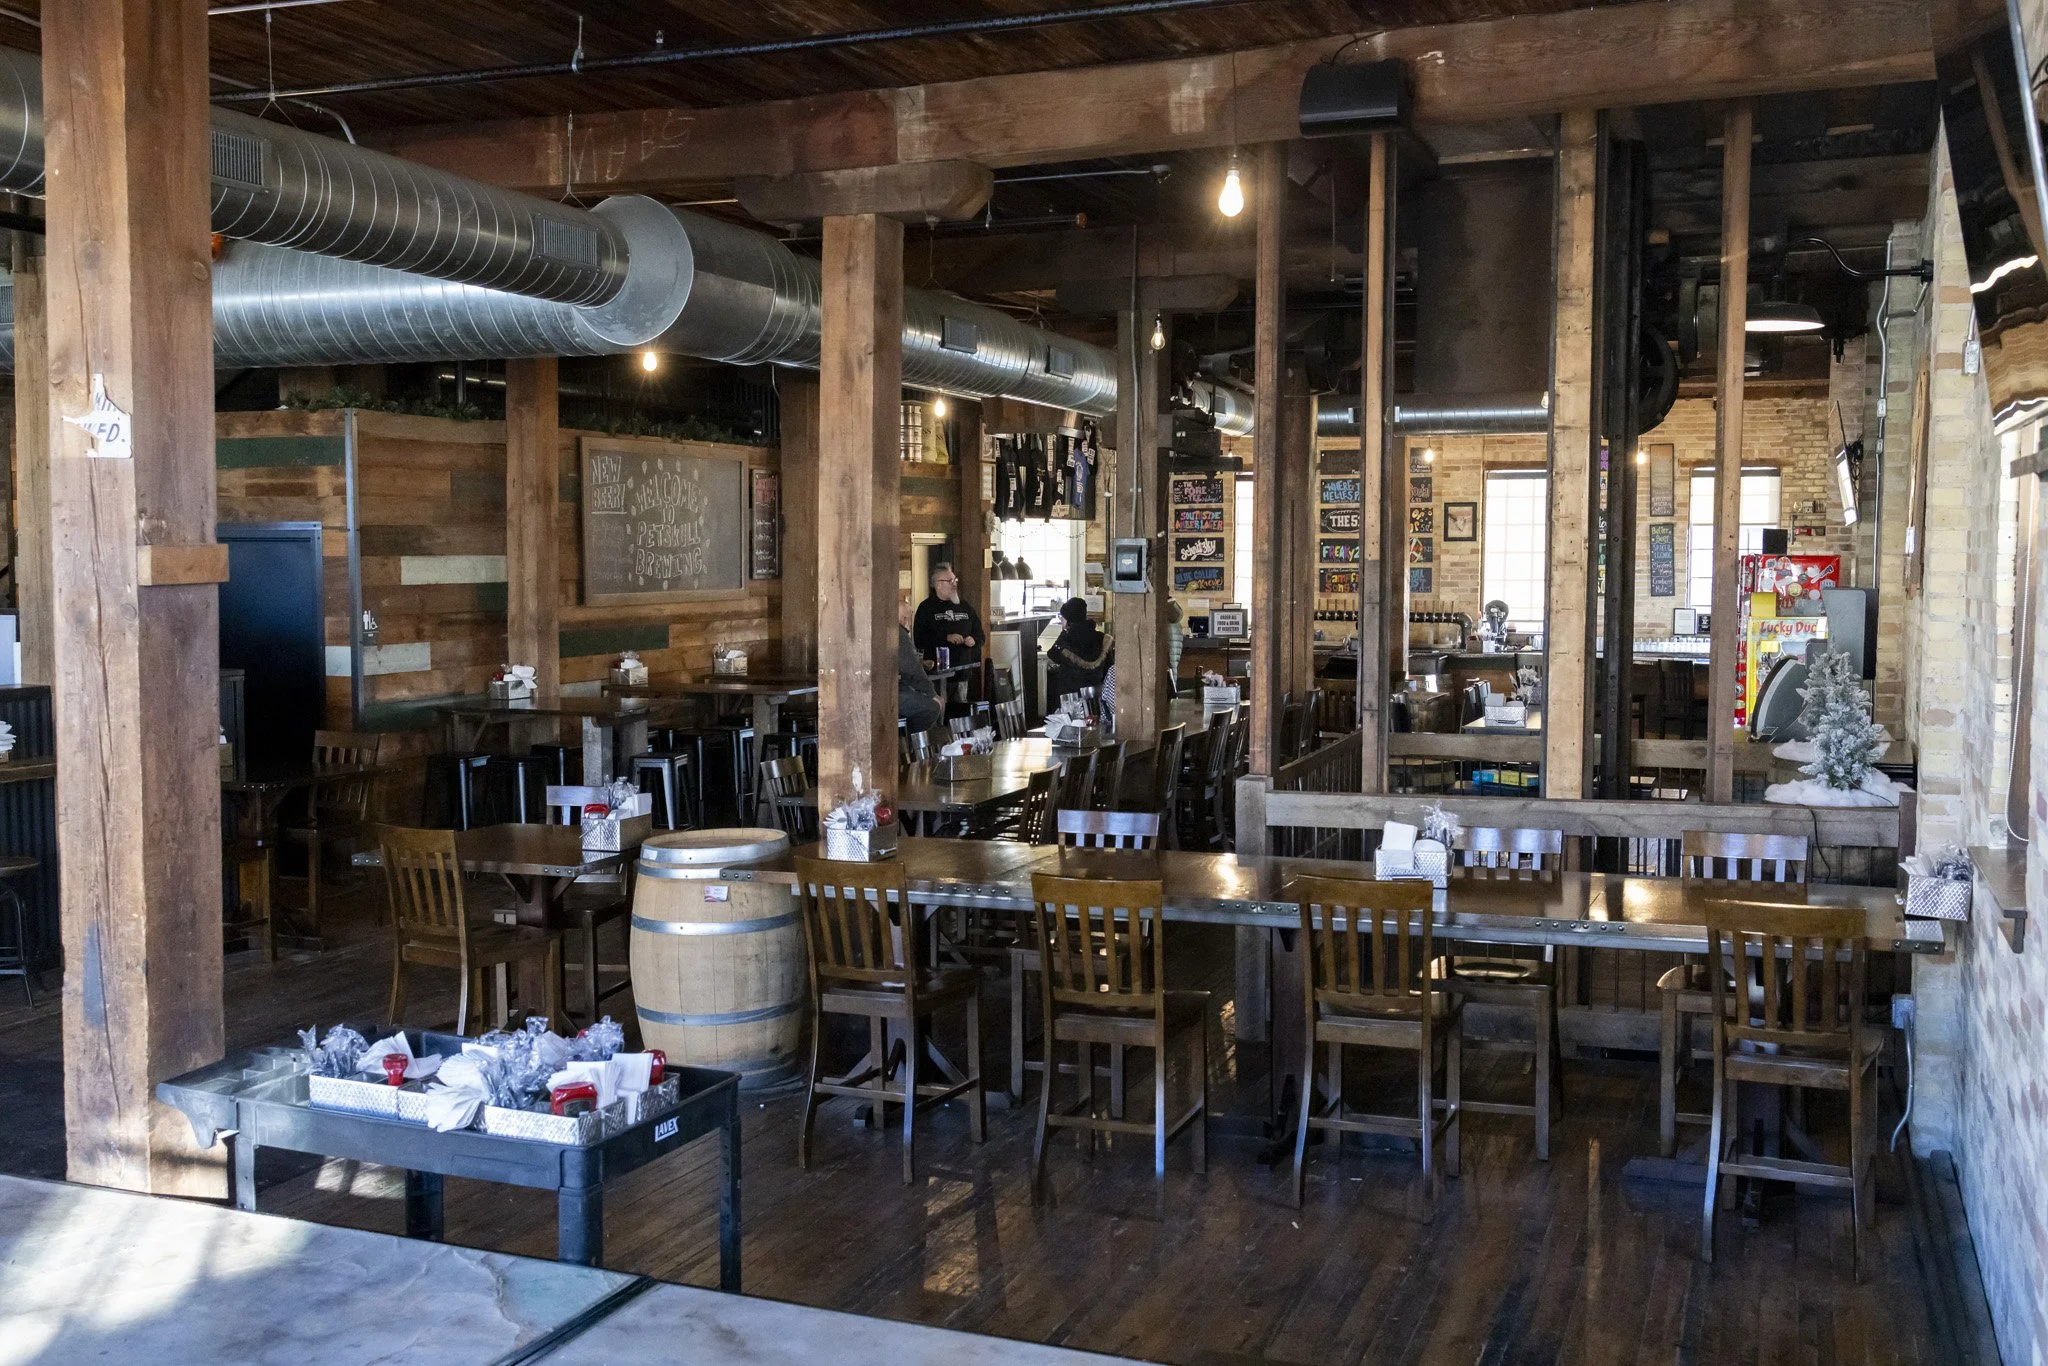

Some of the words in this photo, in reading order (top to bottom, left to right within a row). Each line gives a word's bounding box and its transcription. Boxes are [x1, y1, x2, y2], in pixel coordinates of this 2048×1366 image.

[591, 456, 622, 485] NEW
[637, 472, 702, 514] WELCOME
[1327, 480, 1354, 491] WHERE
[658, 504, 675, 525] TO
[637, 521, 701, 548] PETSKULL
[636, 548, 703, 579] BREWING
[1760, 621, 1793, 637] Lucky
[1795, 621, 1817, 634] Duc
[655, 1116, 680, 1143] LAVEX
